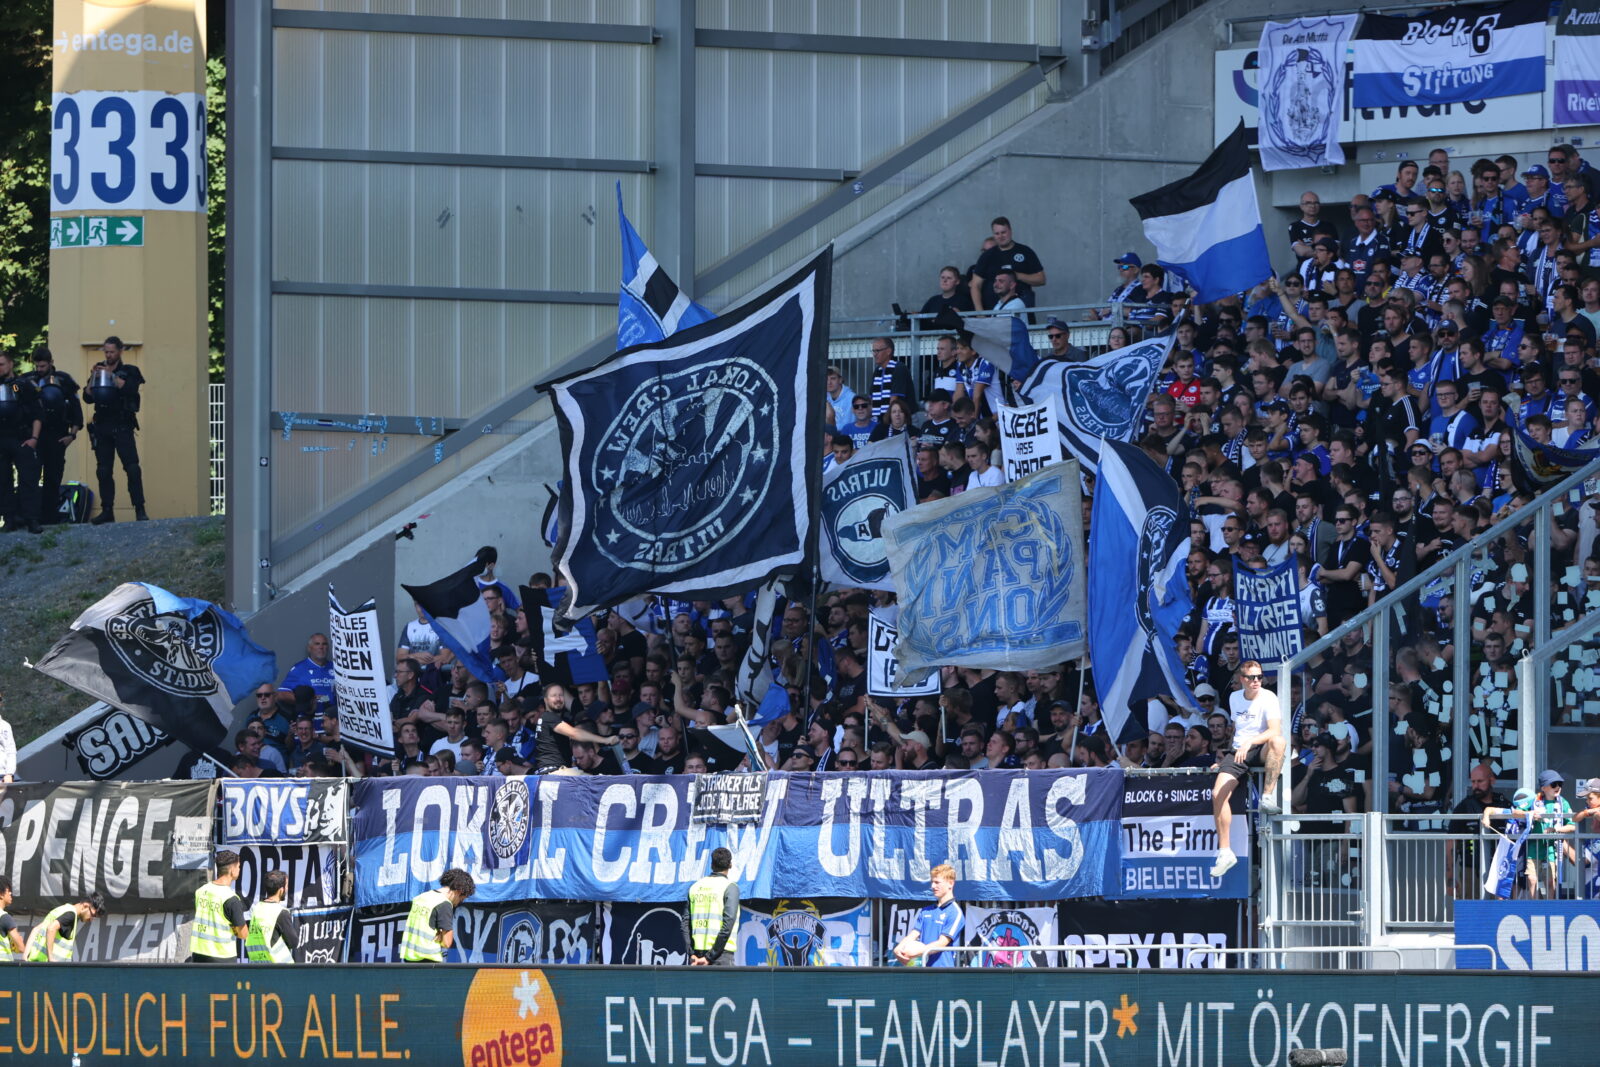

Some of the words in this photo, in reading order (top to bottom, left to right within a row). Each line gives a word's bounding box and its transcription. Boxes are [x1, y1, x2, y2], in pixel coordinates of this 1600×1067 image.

[71, 30, 194, 56] entega.de
[1471, 15, 1497, 54] 6
[1002, 407, 1048, 438] LIEBE
[1016, 441, 1034, 455] HASS
[1238, 599, 1299, 631] ULTRAS
[344, 631, 369, 648] WIR
[1240, 629, 1302, 660] ARMINIA
[348, 686, 377, 699] ALLES
[355, 701, 380, 719] WIR
[743, 775, 761, 792] ALS
[1125, 791, 1155, 803] BLOCK
[1157, 790, 1163, 802] 6
[1171, 790, 1199, 801] SINCE
[224, 785, 309, 837] BOYS
[818, 774, 1088, 882] ULTRAS
[1123, 823, 1164, 852] The
[1172, 822, 1219, 852] Firm
[1125, 866, 1222, 891] BIELEFELD
[209, 981, 287, 1058] FÜR
[300, 992, 411, 1060] ALLE.
[605, 996, 772, 1066] ENTEGA
[1156, 1001, 1235, 1067] MIT
[1248, 988, 1555, 1067] ÖKOENERGIE
[471, 1022, 556, 1067] entega
